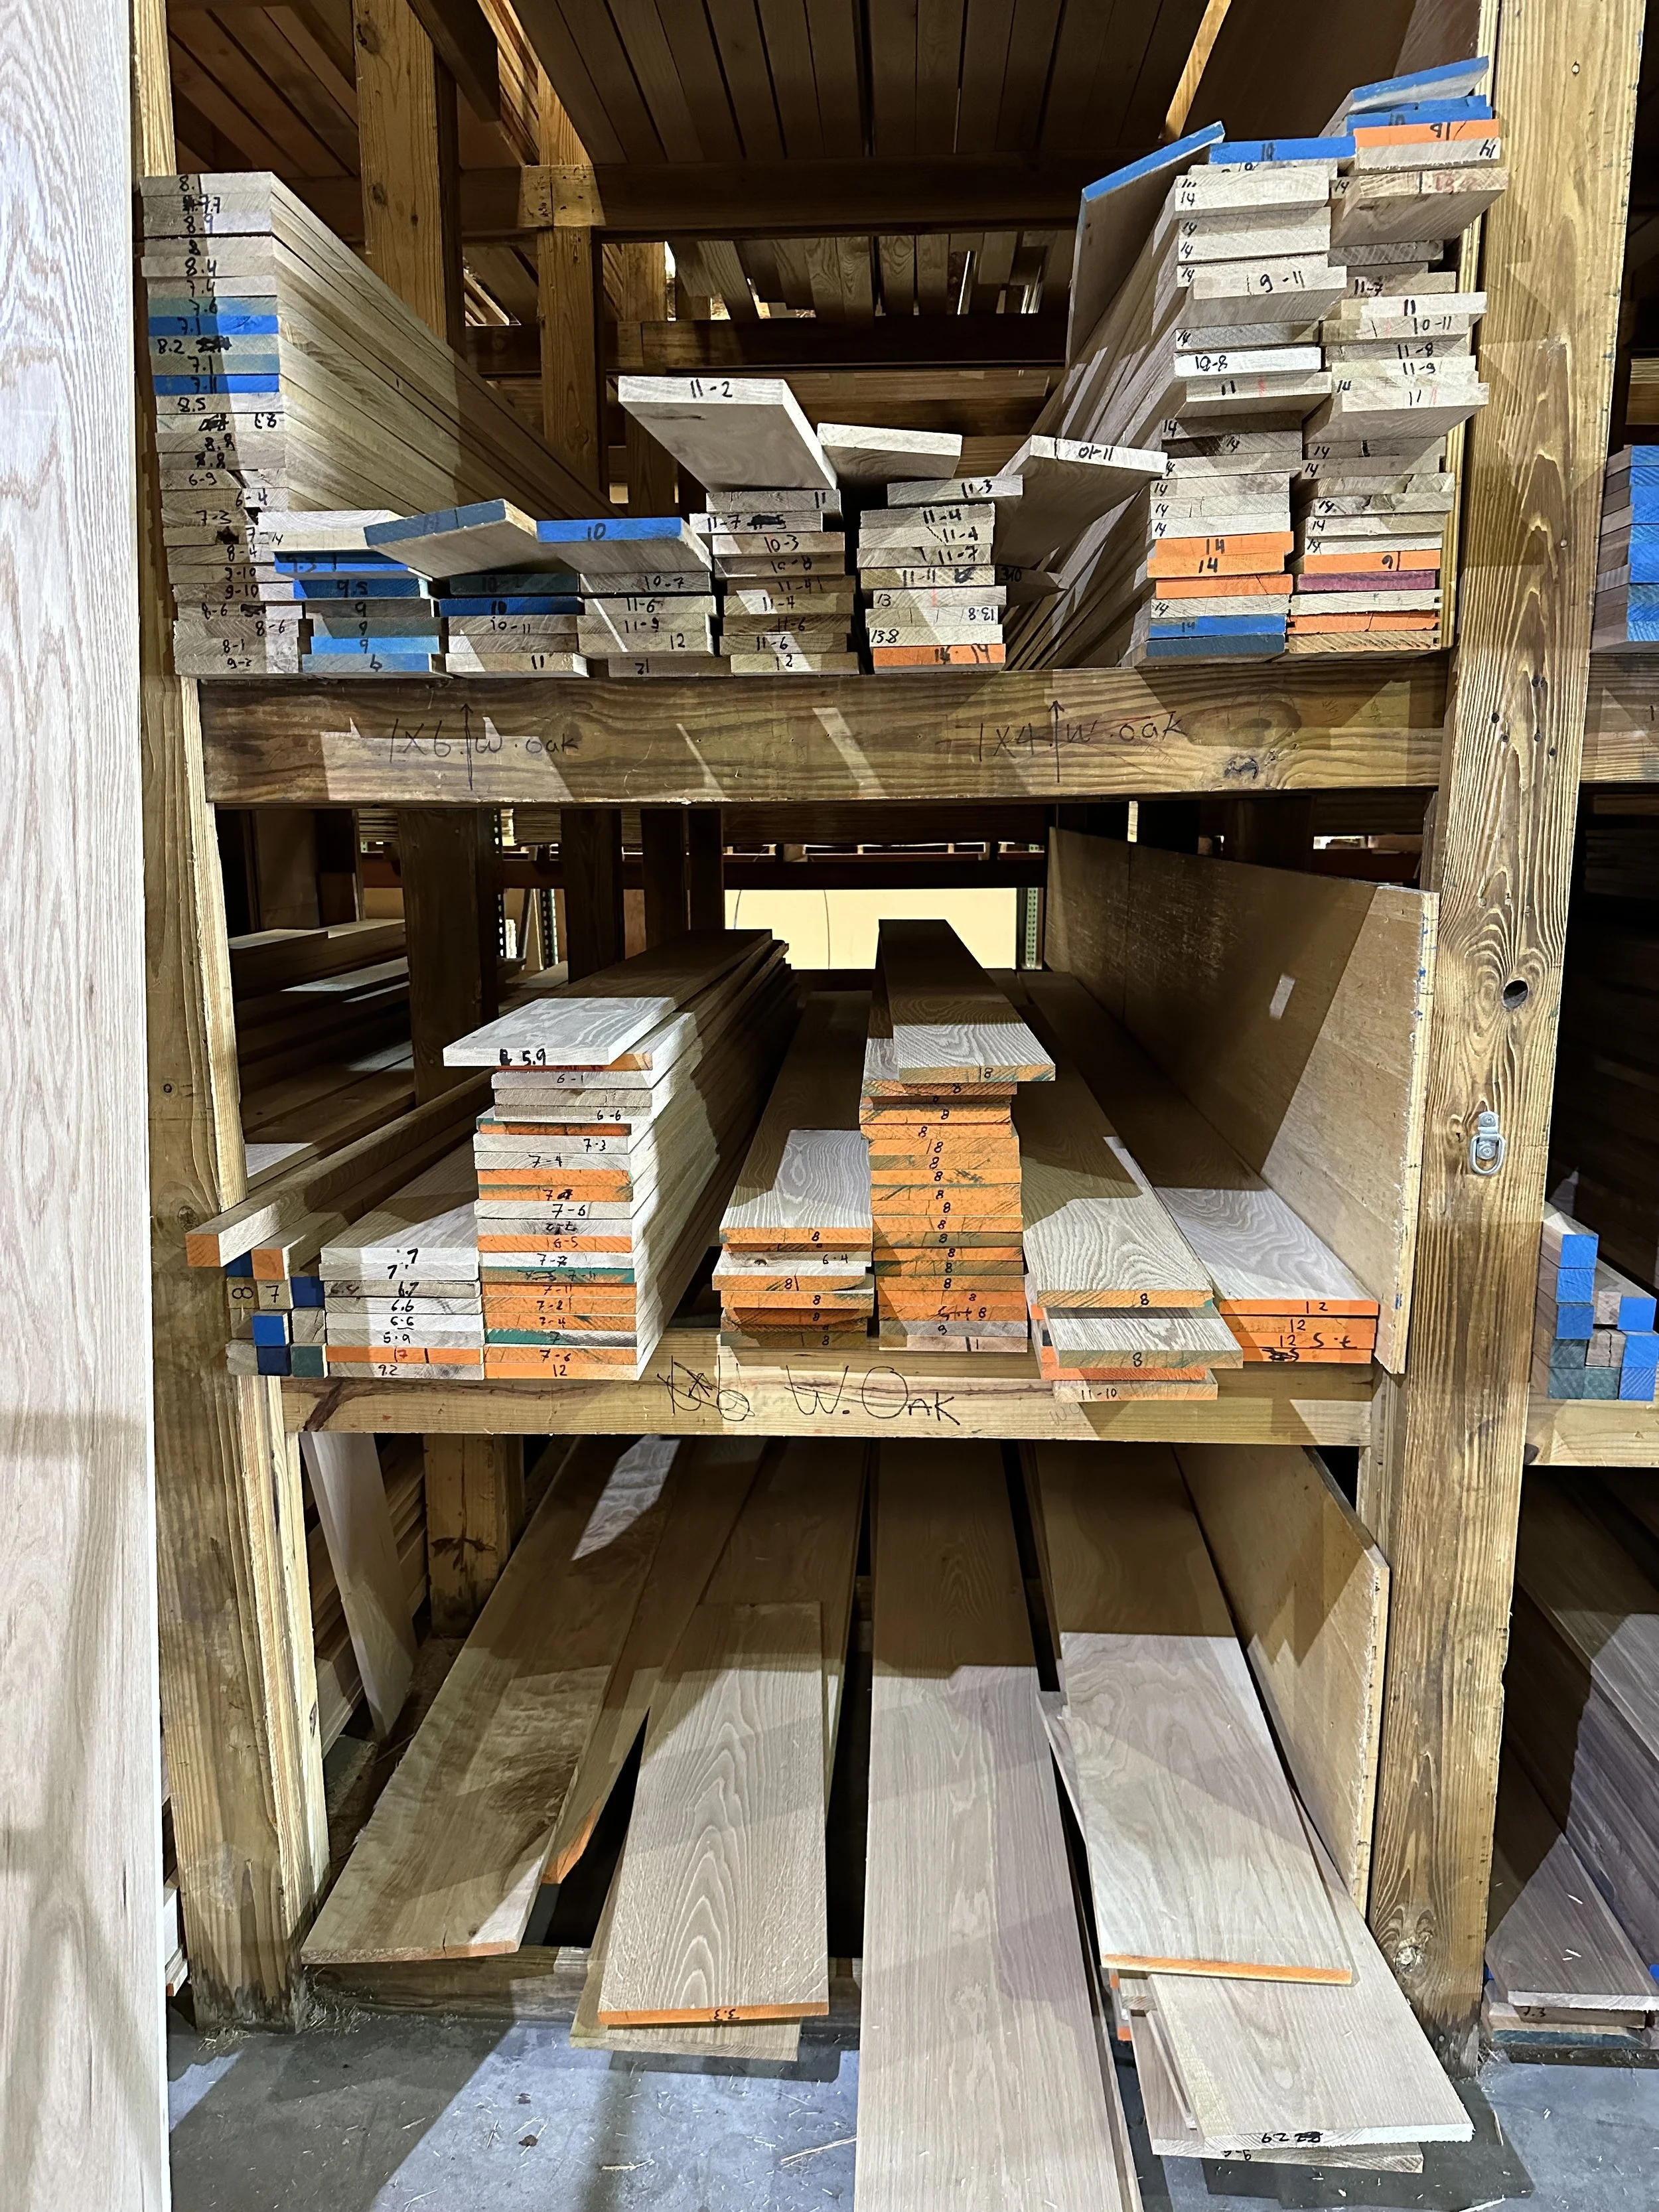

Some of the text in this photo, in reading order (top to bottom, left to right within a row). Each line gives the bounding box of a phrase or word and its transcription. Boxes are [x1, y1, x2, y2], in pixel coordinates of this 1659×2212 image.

[1334, 179, 1350, 194] 14
[1181, 192, 1195, 206] 14
[1182, 222, 1197, 237] 14
[1181, 242, 1193, 258] 14
[185, 257, 217, 276] 8.4
[1182, 267, 1194, 282] 14
[1260, 271, 1305, 293] 9-11
[1404, 299, 1416, 316] 11
[1413, 316, 1452, 334] 10-11
[1177, 330, 1191, 346] 14
[157, 338, 184, 354] 8.2
[1398, 342, 1433, 359] 11-8
[1403, 362, 1435, 375] 11-9
[689, 378, 733, 398] 11-2
[1221, 380, 1236, 396] 11
[1336, 380, 1351, 393] 14
[1409, 390, 1421, 406] 11
[1164, 419, 1178, 437] 14
[1227, 437, 1240, 452] 14
[1314, 446, 1330, 459] 14
[1305, 463, 1319, 477] 14
[188, 472, 217, 486] 6-9
[1154, 482, 1167, 496] 14
[236, 488, 267, 507] 6-4
[814, 491, 826, 508] 11
[1155, 504, 1169, 517] 14
[1319, 500, 1334, 514] 14
[196, 510, 232, 526] 7-3
[707, 514, 741, 532] 11-7
[923, 508, 962, 524] 11-4
[587, 523, 606, 541] 10
[1155, 522, 1167, 536] 14
[1312, 519, 1326, 531] 14
[272, 532, 283, 546] 14
[943, 526, 978, 543] 11-4
[764, 534, 799, 553] 10-3
[1206, 538, 1225, 555] 14
[226, 544, 257, 561] 8-4
[1198, 557, 1218, 573] 14
[644, 575, 684, 590] 10-7
[224, 585, 259, 599] 9-10
[626, 597, 655, 613] 11-6
[877, 593, 891, 607] 13
[202, 603, 228, 619] 8-6
[354, 601, 366, 617] 9
[1155, 602, 1169, 617] 14
[255, 619, 285, 636] 8-6
[778, 617, 806, 632] 11-6
[222, 638, 245, 653] 8-1
[360, 639, 368, 654] 9
[670, 633, 685, 650] 12
[757, 636, 788, 651] 11-6
[532, 655, 544, 670] 11
[776, 653, 793, 671] 12
[522, 1048, 545, 1065] 5.9
[557, 1074, 584, 1084] 6-1
[984, 1067, 993, 1078] 8
[597, 1108, 621, 1121] 6-6
[918, 1126, 927, 1138] 8
[583, 1139, 606, 1152] 7-3
[934, 1142, 944, 1153] 8
[529, 1154, 562, 1169] 7-4
[929, 1156, 940, 1169] 8
[934, 1171, 943, 1181] 8
[935, 1190, 944, 1199] 8
[551, 1203, 586, 1218] 7-6
[943, 1202, 951, 1213] 8
[938, 1220, 947, 1230] 8
[812, 1231, 820, 1242] 8
[938, 1234, 948, 1243] 8
[948, 1248, 956, 1257] 8
[945, 1262, 952, 1273] 8
[784, 1278, 793, 1290] 8
[944, 1278, 952, 1289] 8
[265, 1285, 279, 1303] 7
[812, 1295, 821, 1305] 8
[1140, 1293, 1149, 1305] 8
[392, 1299, 414, 1312] 6.6
[978, 1307, 987, 1318] 8
[1291, 1319, 1306, 1333] 12
[384, 1331, 410, 1343] 5.9
[822, 1335, 830, 1345] 8
[1280, 1335, 1296, 1347] 12
[1133, 1352, 1142, 1367] 8
[553, 1364, 567, 1376] 12
[1082, 1388, 1117, 1400] 11-10
